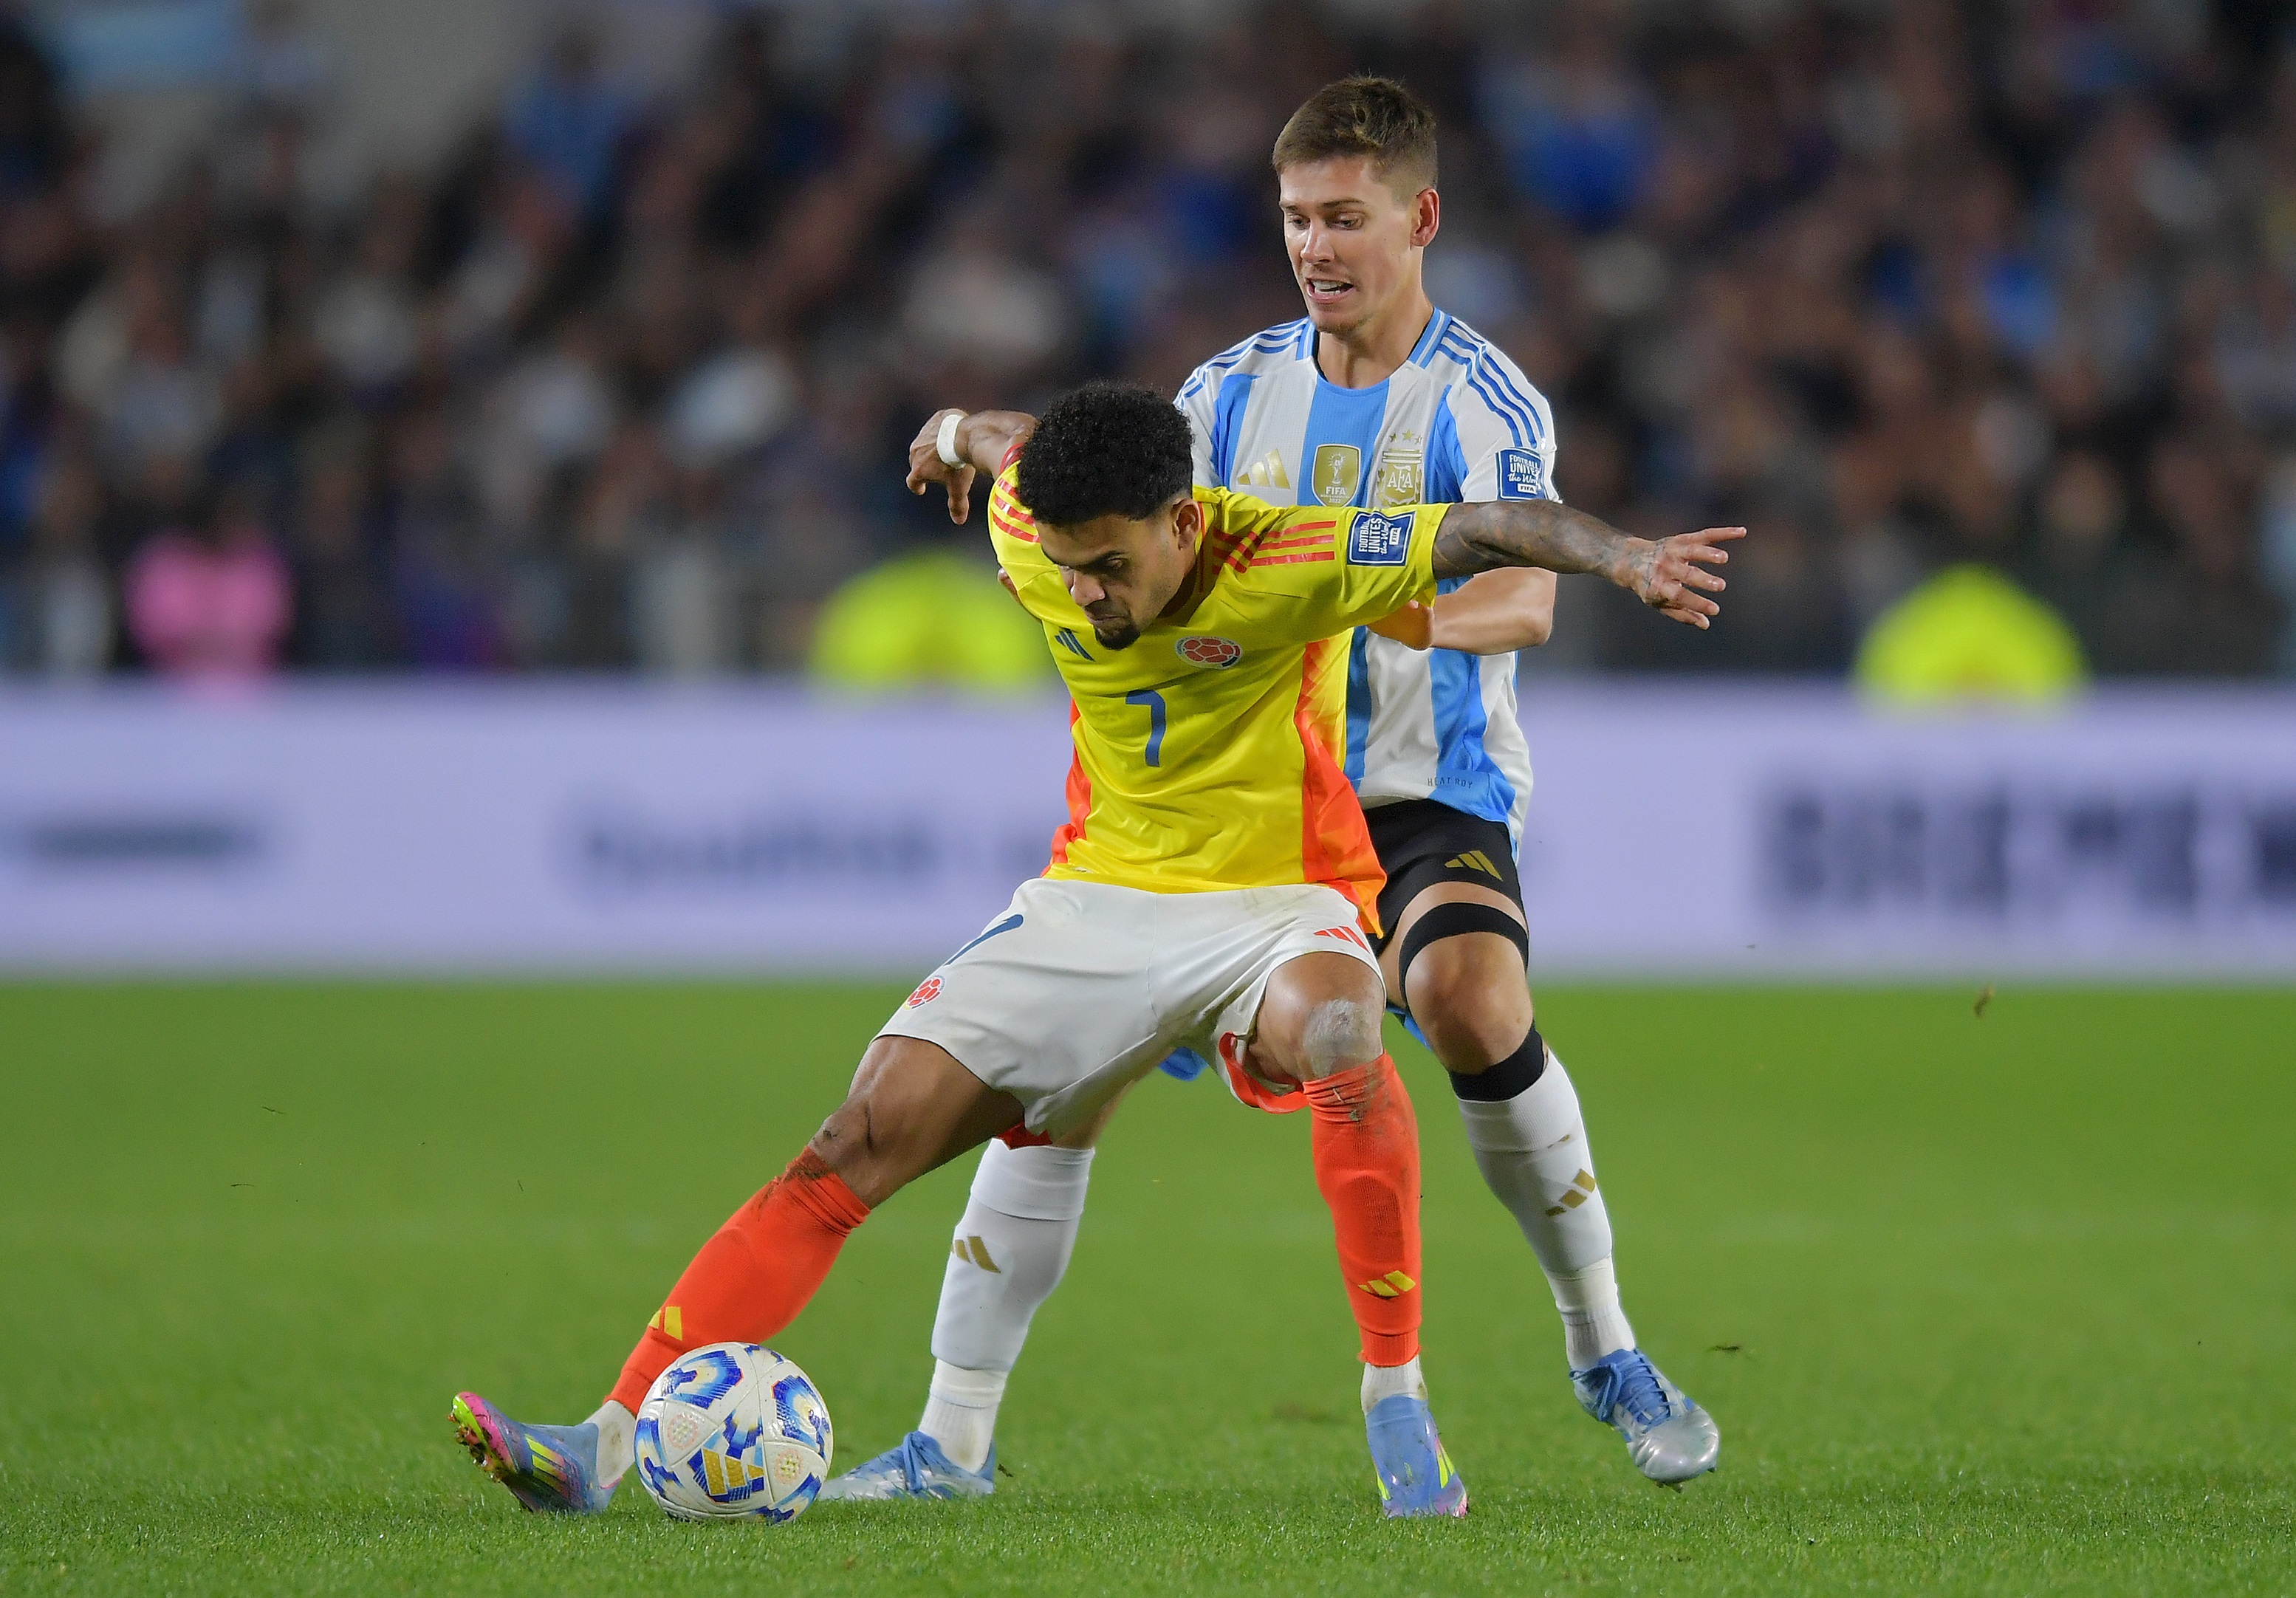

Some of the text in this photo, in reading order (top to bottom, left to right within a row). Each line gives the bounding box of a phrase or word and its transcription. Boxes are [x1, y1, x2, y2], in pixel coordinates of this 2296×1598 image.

[1326, 486, 1346, 495] FIFA
[1368, 518, 1382, 553] UNITES
[1125, 689, 1167, 767] 7
